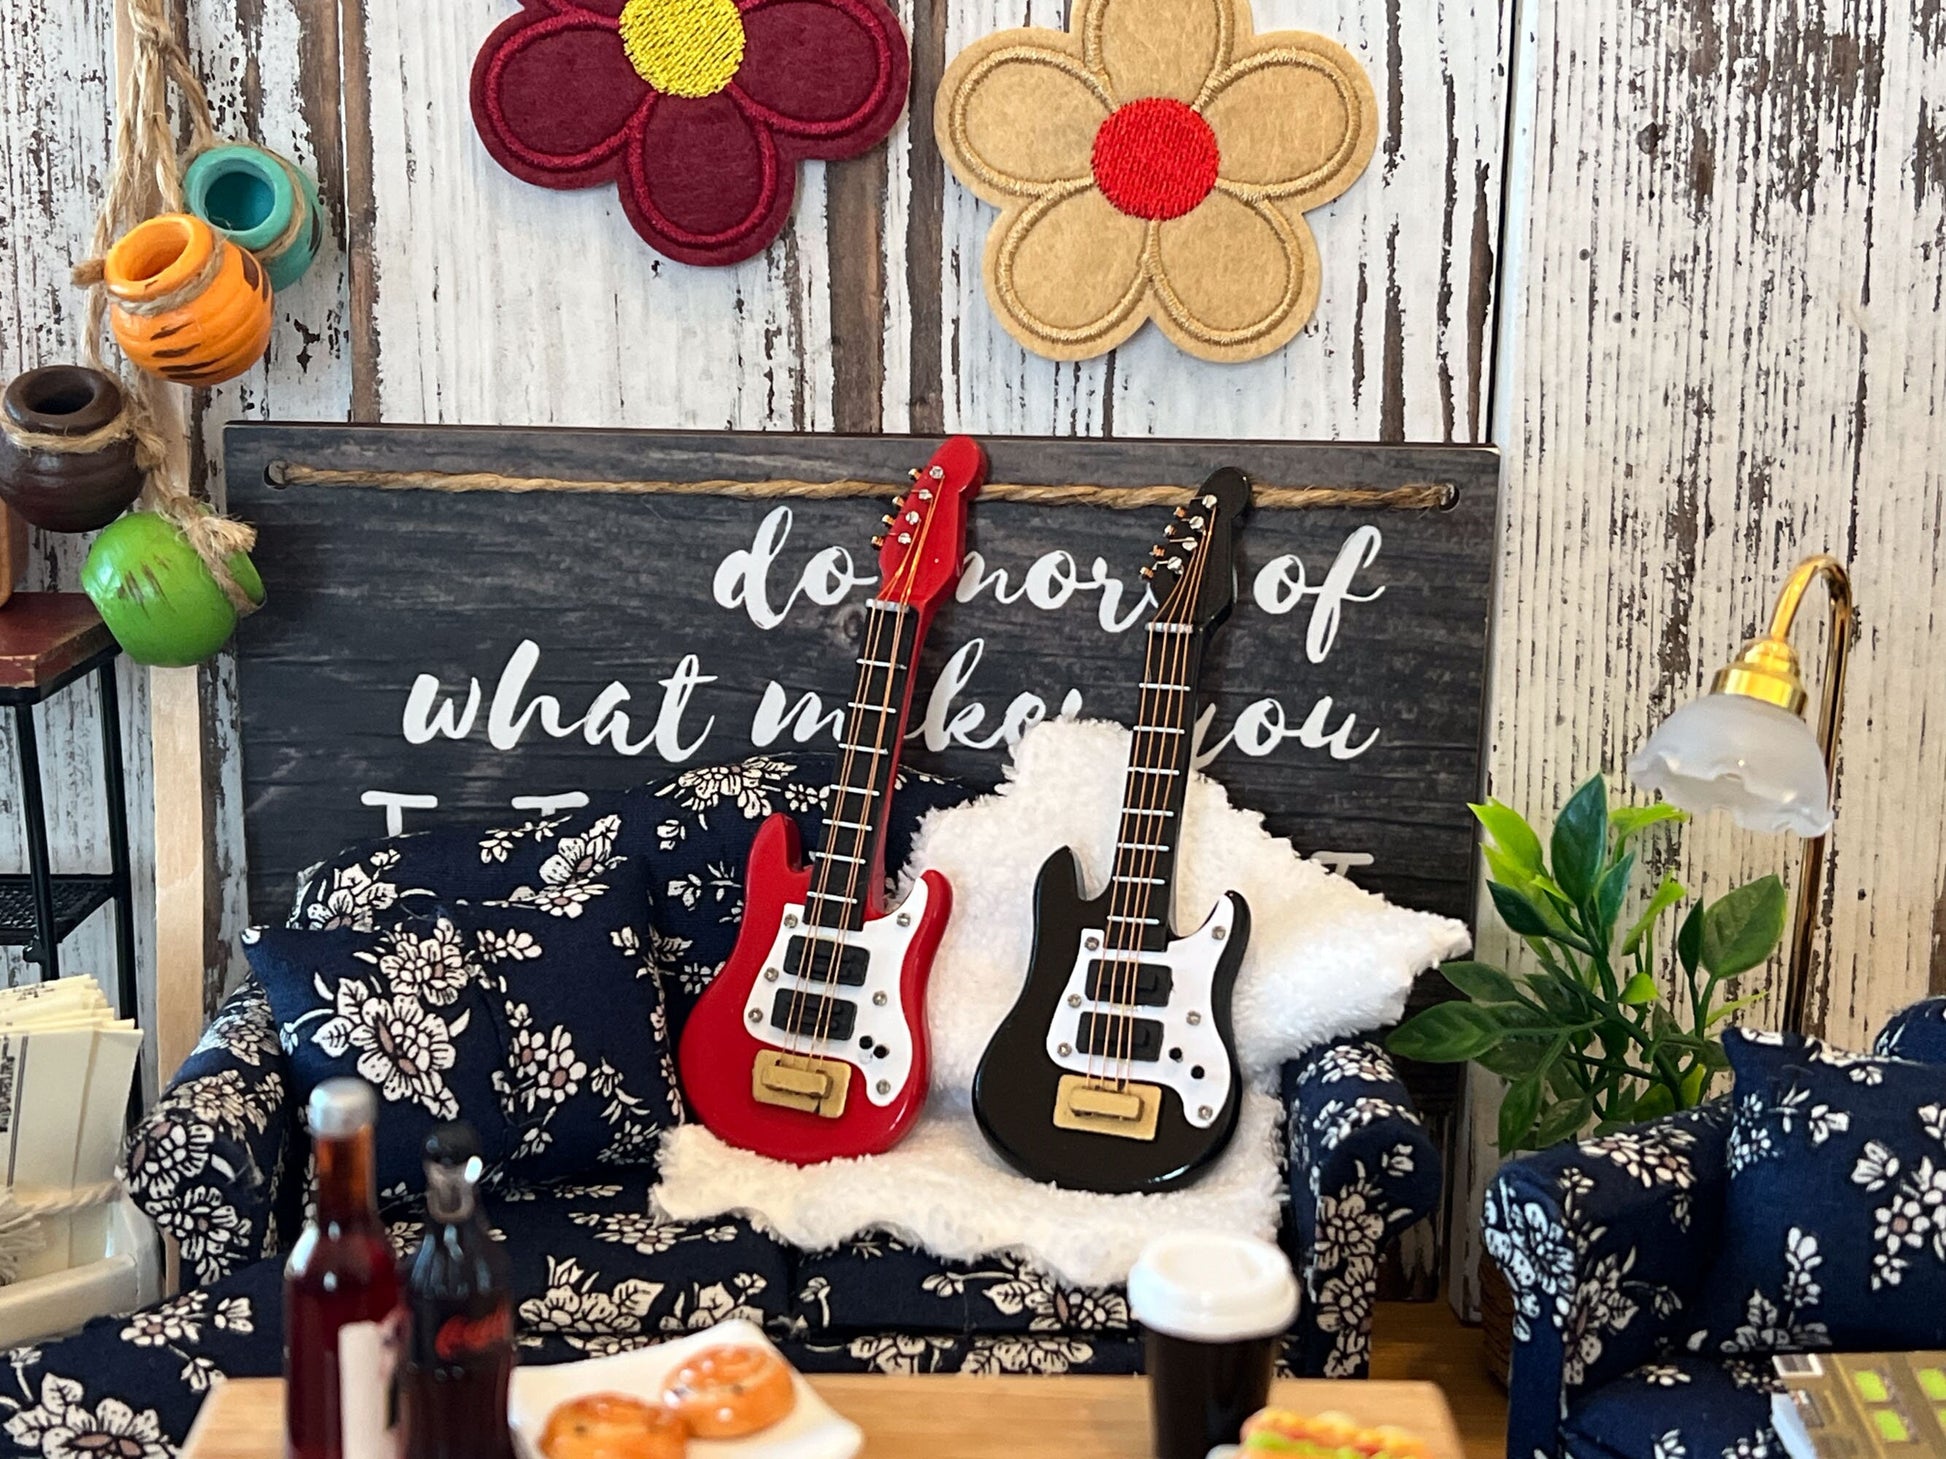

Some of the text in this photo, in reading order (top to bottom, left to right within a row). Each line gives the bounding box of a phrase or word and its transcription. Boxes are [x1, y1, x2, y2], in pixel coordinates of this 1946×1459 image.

[713, 505, 878, 630] do
[1253, 525, 1386, 664] of
[402, 638, 718, 763] what
